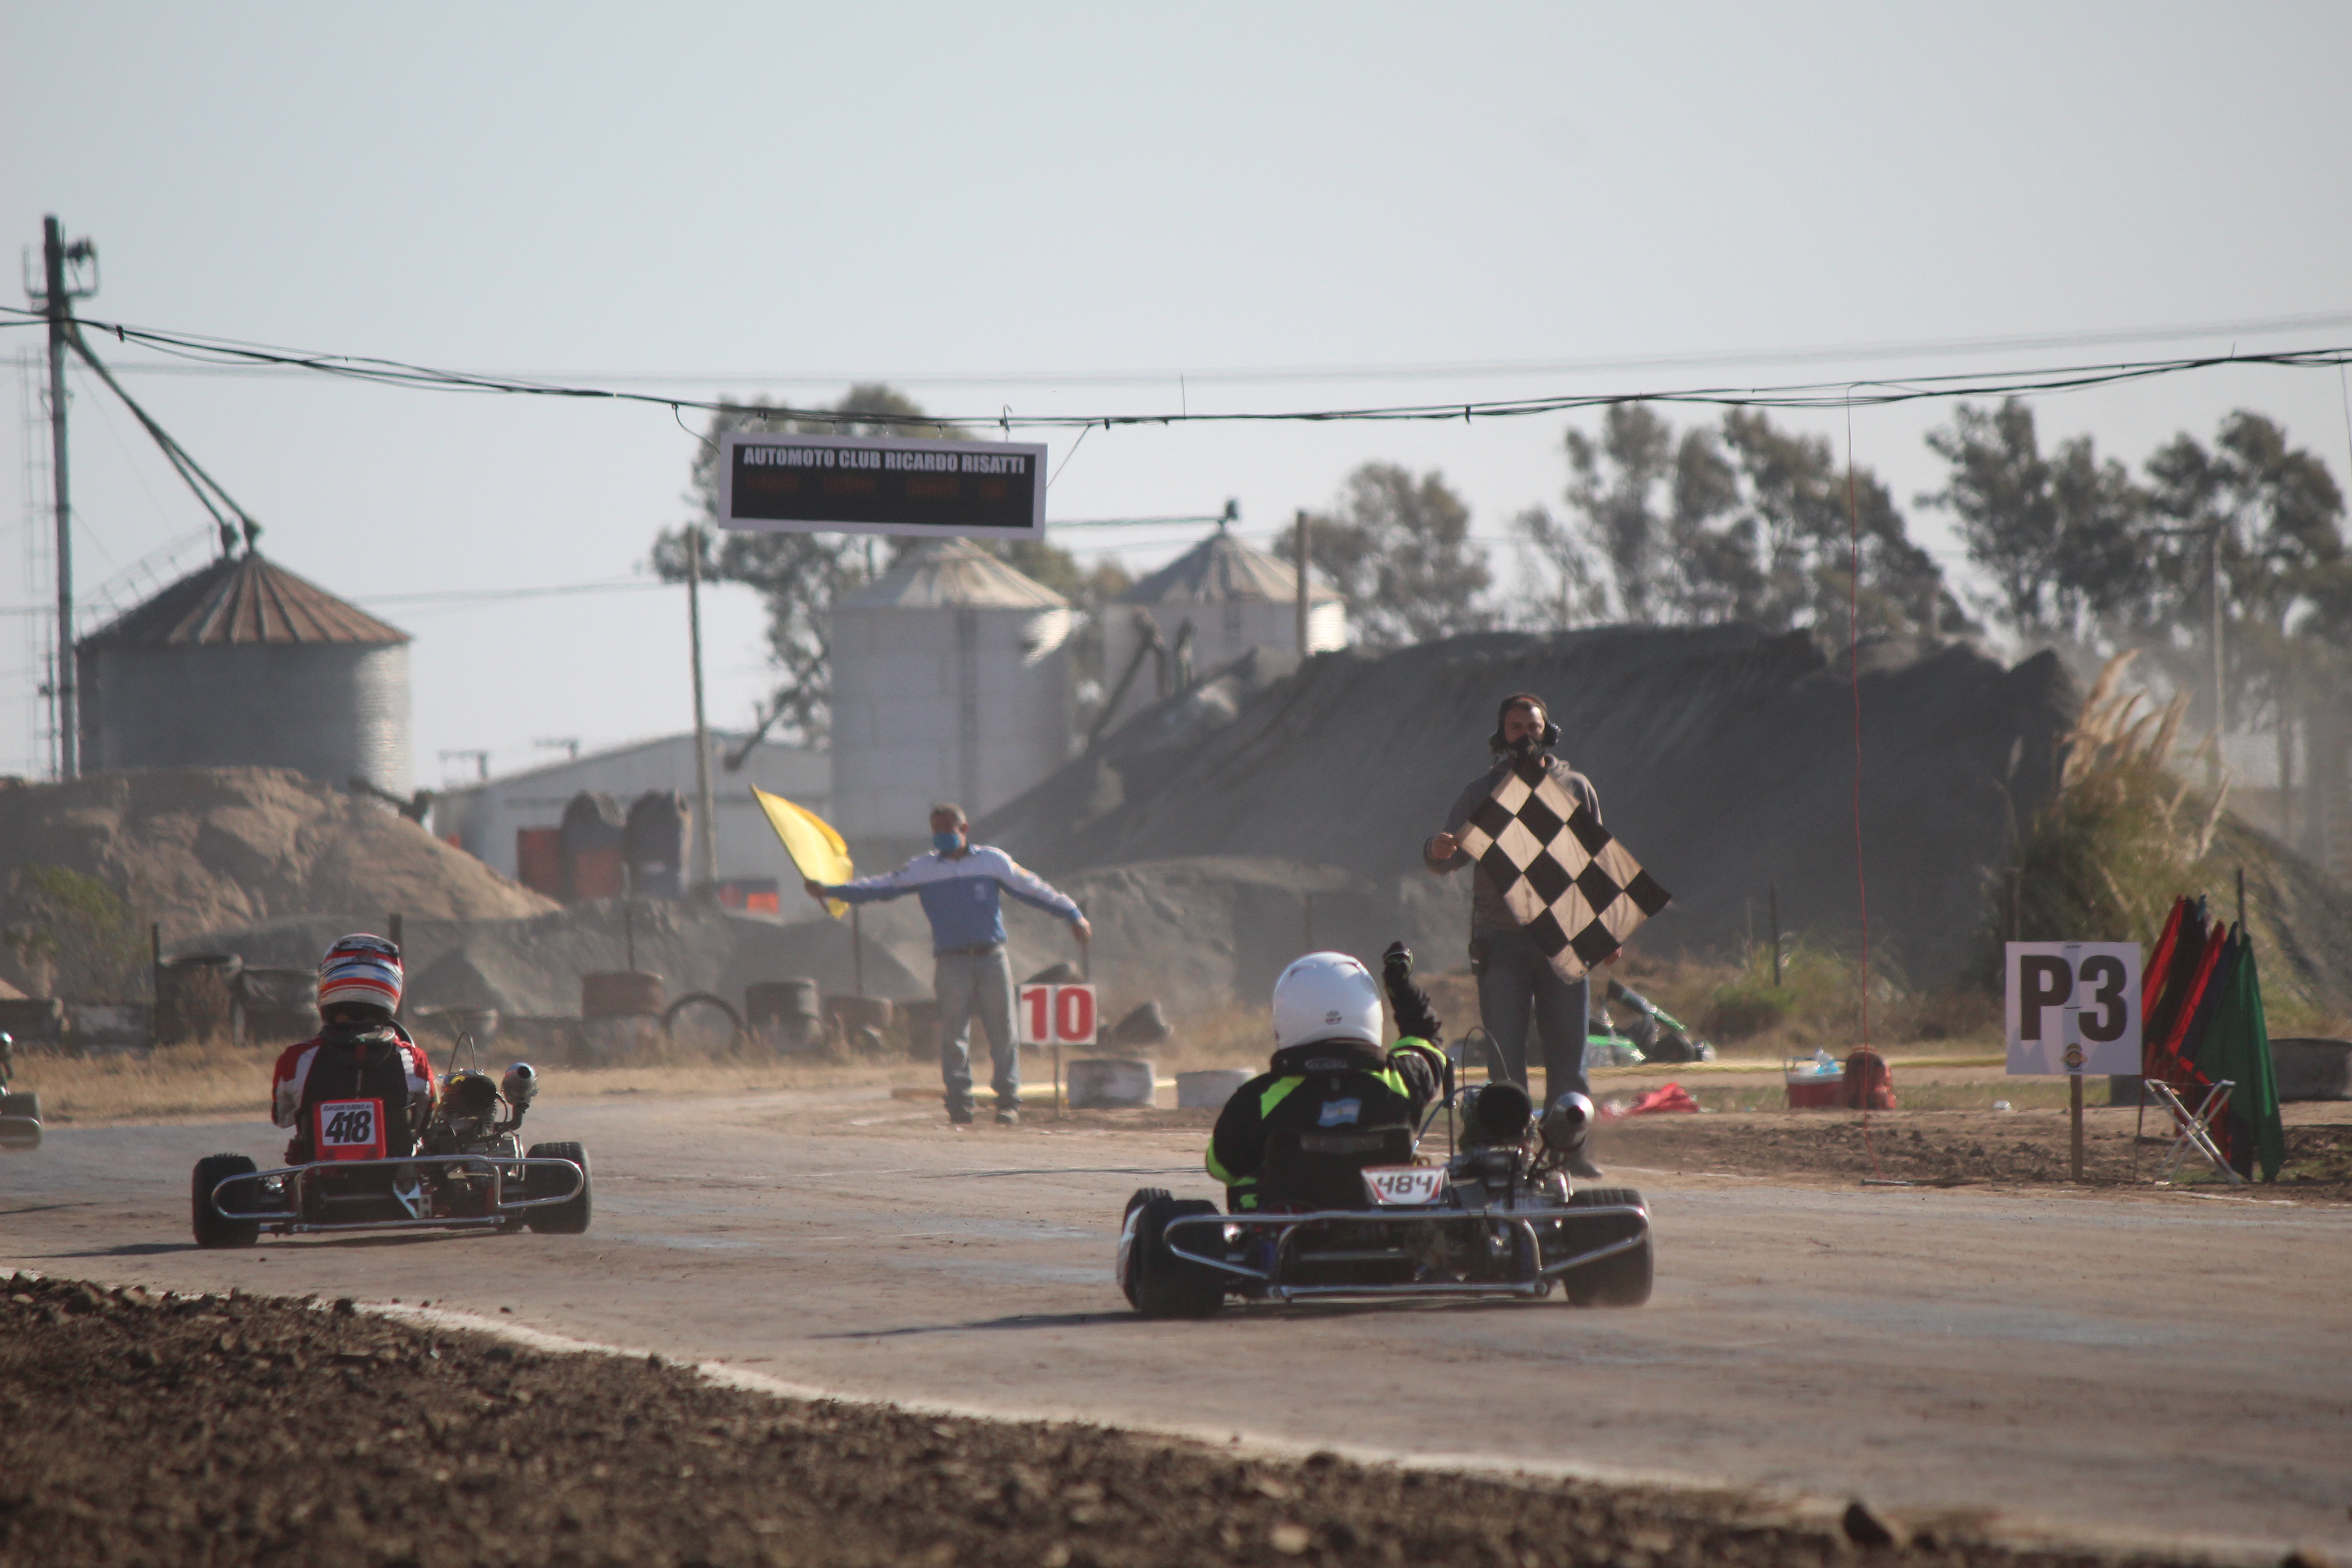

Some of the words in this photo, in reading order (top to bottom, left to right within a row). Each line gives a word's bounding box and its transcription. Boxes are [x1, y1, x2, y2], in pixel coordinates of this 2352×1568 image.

[743, 446, 835, 467] AUTOMOTO
[839, 449, 881, 469] CLUB
[885, 451, 958, 472] RICARDO
[961, 454, 1025, 474] RISATTI
[2020, 955, 2127, 1041] P3
[1022, 988, 1093, 1041] 10
[325, 1111, 371, 1143] 418
[1377, 1176, 1433, 1195] 484
